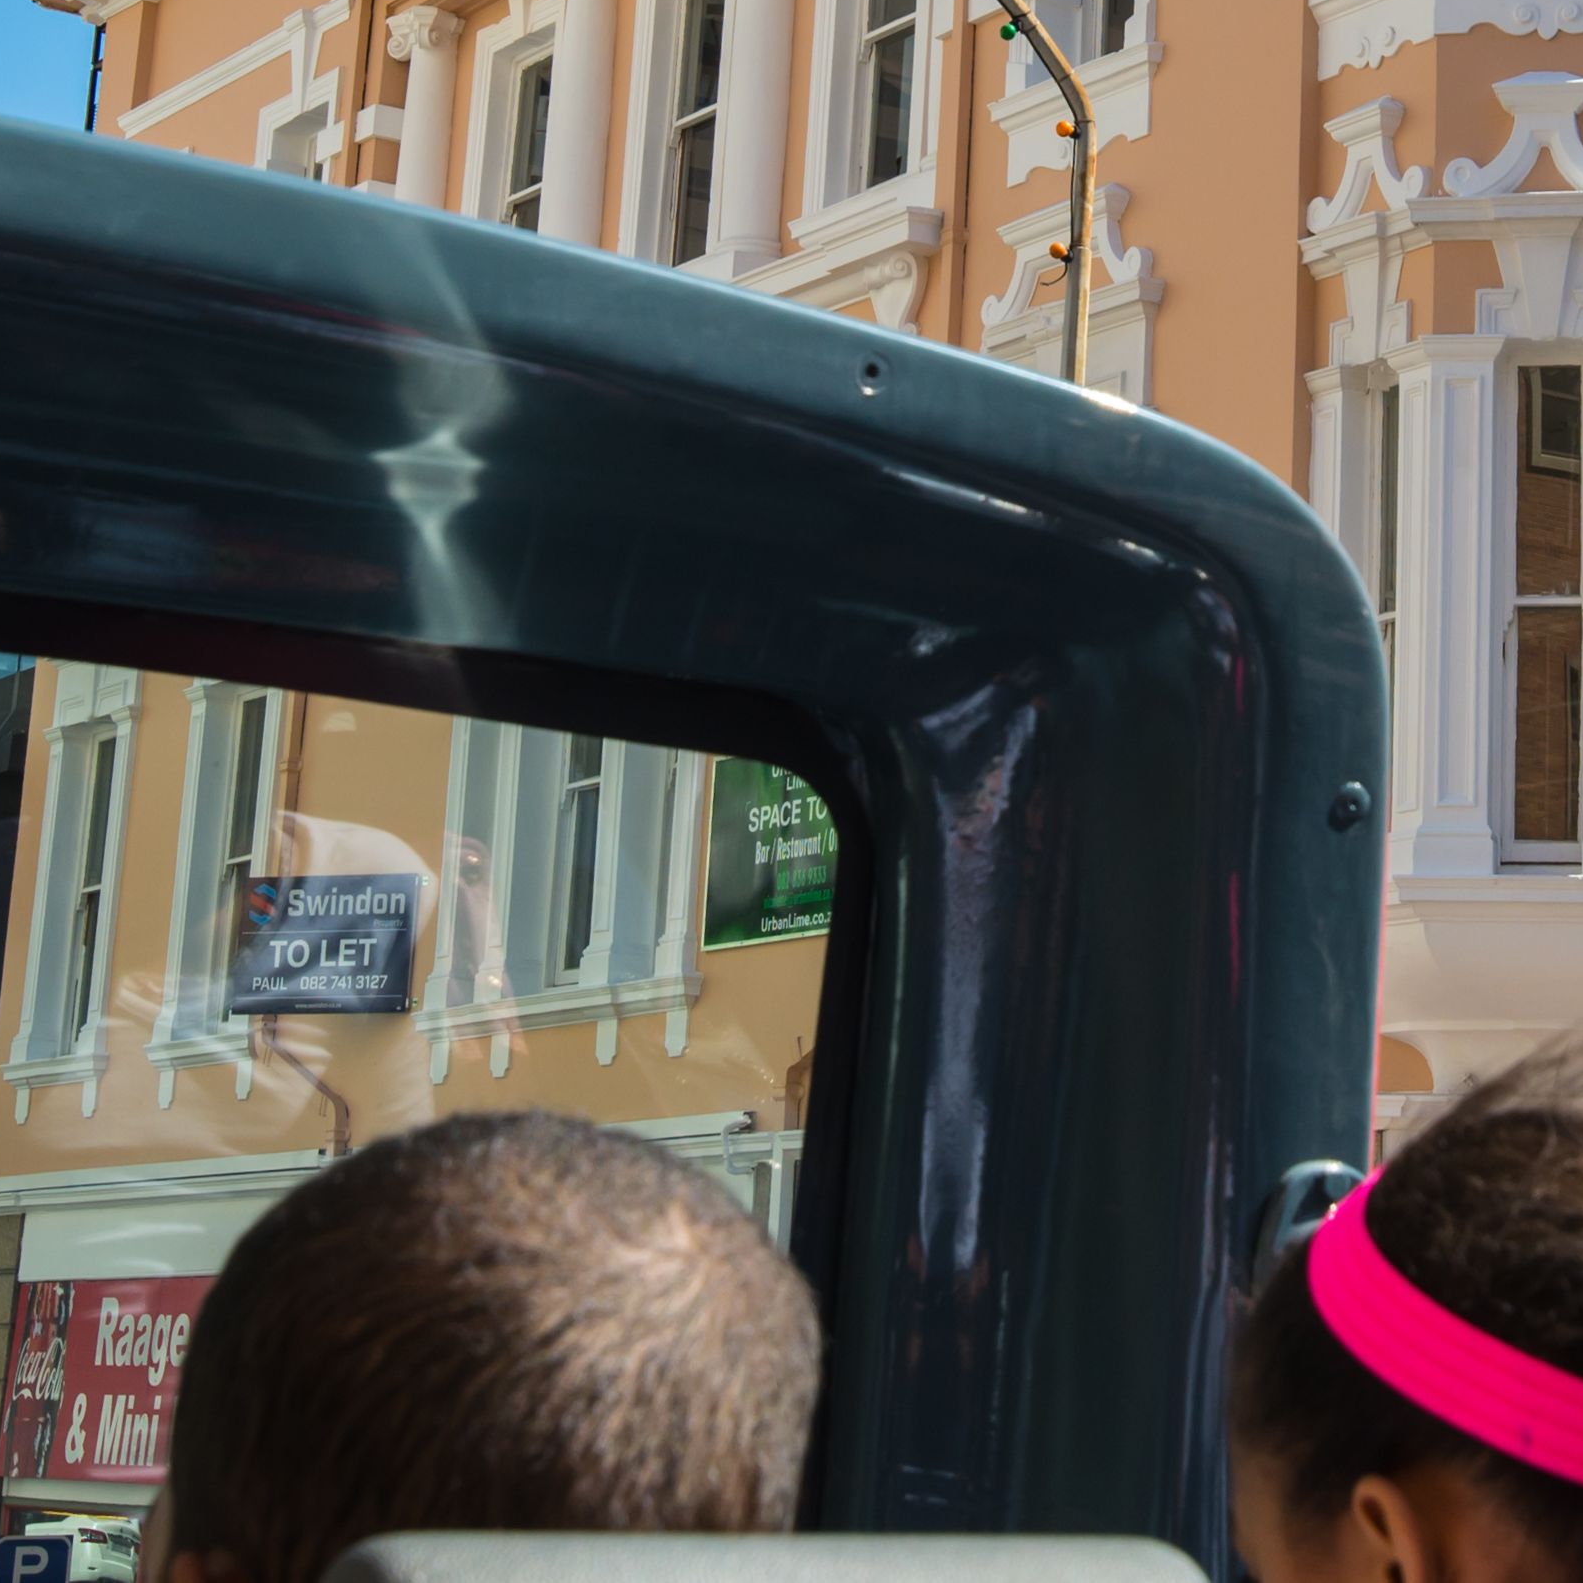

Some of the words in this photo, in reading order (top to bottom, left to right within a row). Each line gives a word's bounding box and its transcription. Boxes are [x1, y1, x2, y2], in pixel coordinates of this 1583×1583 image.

[748, 798, 802, 833] SPACE
[754, 841, 769, 865] Bar
[776, 833, 821, 862] Restaurant
[287, 887, 406, 917] Swindon
[760, 909, 832, 933] UrbanLime.co.z
[269, 939, 310, 968] TO
[319, 938, 378, 967] LET
[252, 976, 288, 991] PAUL
[299, 976, 327, 990] 082
[330, 975, 352, 990] 741
[355, 974, 388, 990] 3127
[94, 1296, 191, 1387] Raage
[64, 1392, 88, 1465] &
[93, 1393, 162, 1467] Mini
[12, 1545, 50, 1583] P
